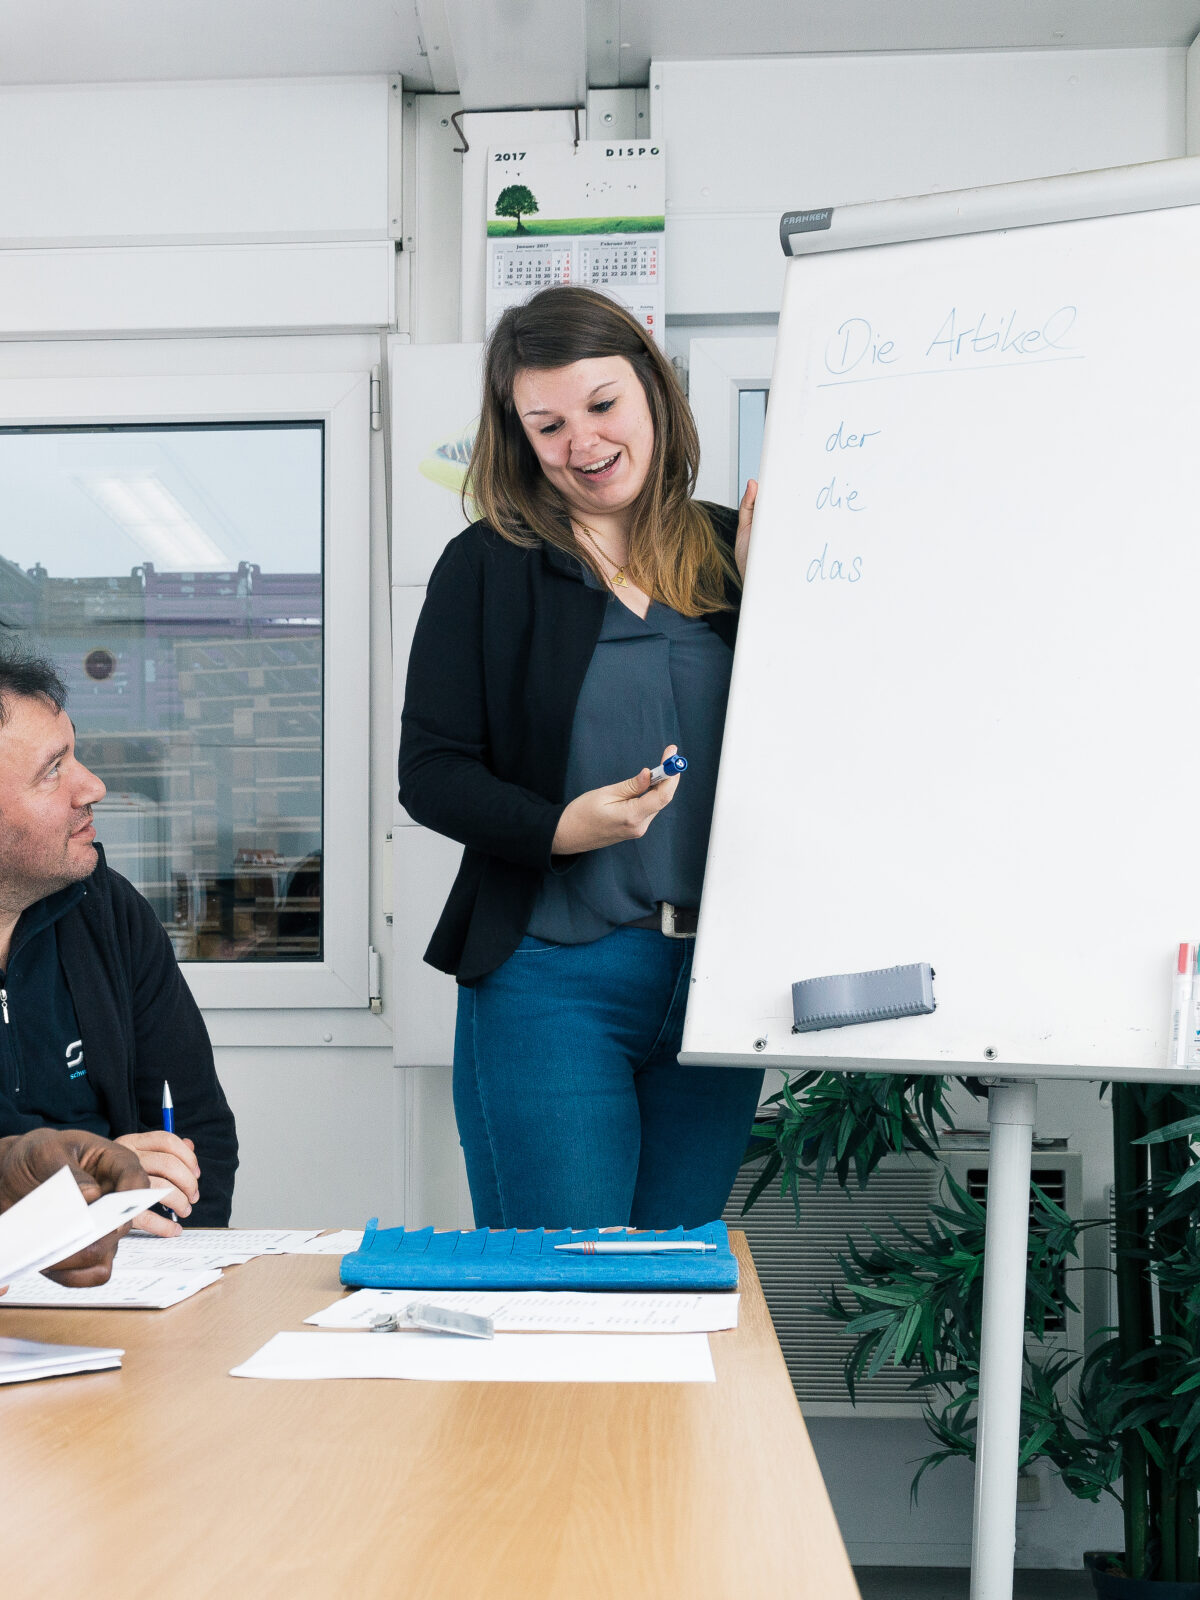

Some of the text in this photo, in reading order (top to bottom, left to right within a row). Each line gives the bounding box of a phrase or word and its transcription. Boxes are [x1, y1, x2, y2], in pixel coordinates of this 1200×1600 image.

[494, 152, 527, 162] 2017
[606, 147, 660, 157] DISPO
[783, 212, 829, 225] FRANKEN
[646, 315, 654, 325] 5
[824, 304, 1081, 375] Die Artikel
[825, 420, 882, 453] der
[815, 475, 867, 512] die
[805, 542, 863, 584] das
